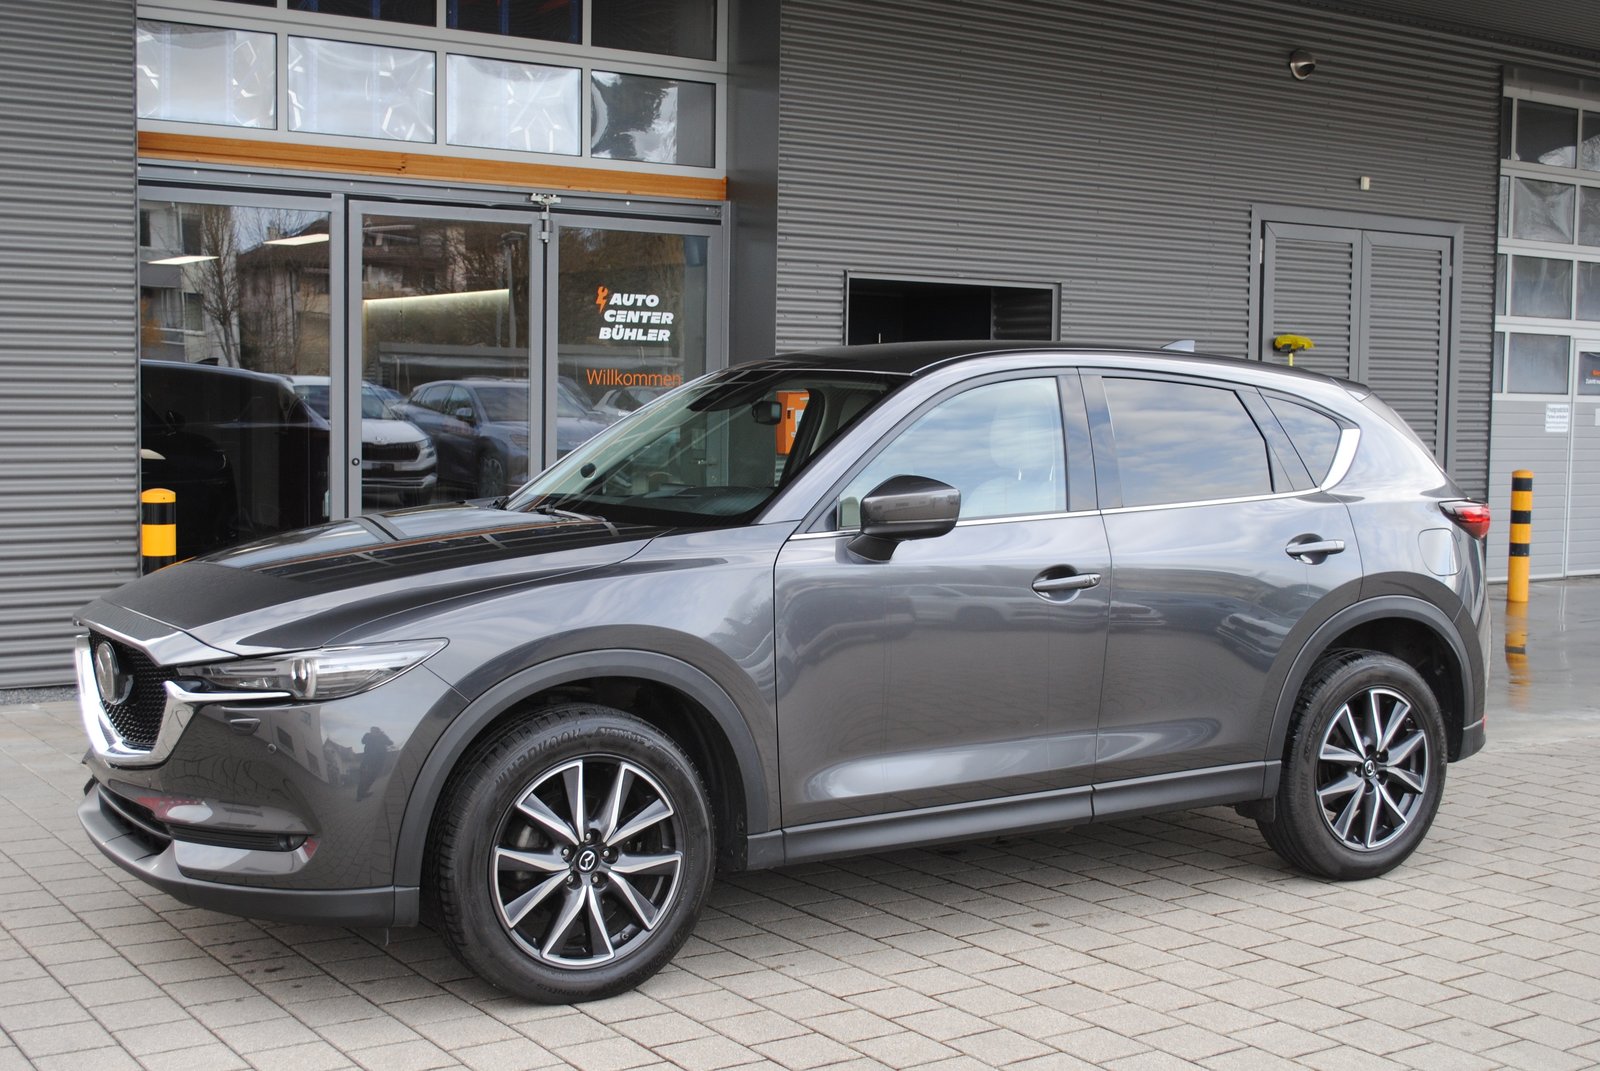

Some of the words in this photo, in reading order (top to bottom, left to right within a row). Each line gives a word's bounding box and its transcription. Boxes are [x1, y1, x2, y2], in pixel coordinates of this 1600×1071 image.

[609, 293, 660, 307] AUTO
[603, 309, 674, 325] CENTER
[598, 324, 671, 342] BÜHLER
[586, 368, 682, 387] Willkommen
